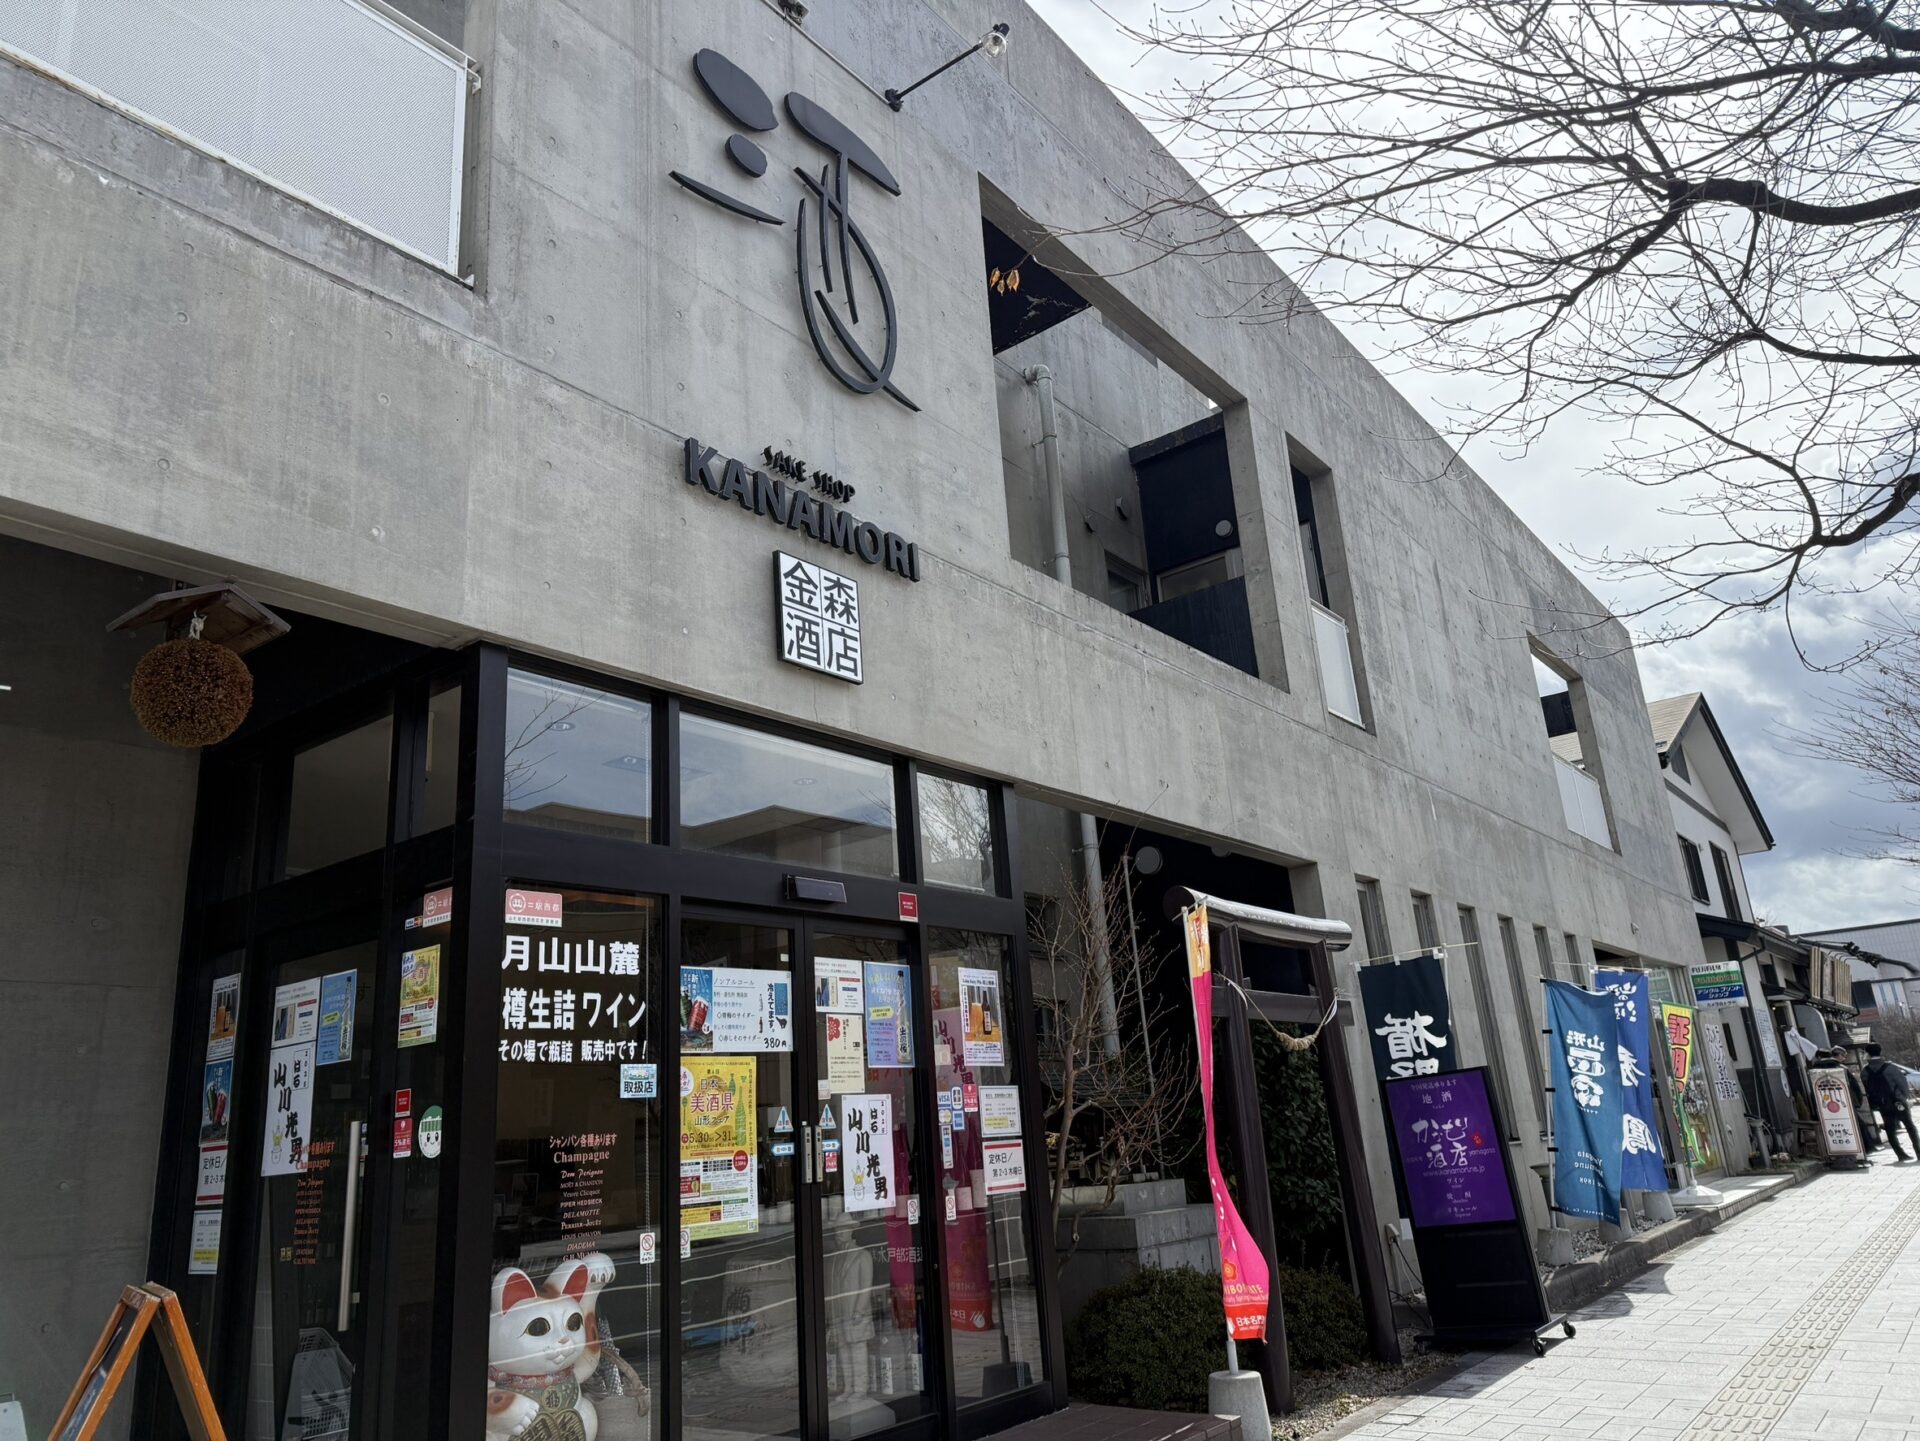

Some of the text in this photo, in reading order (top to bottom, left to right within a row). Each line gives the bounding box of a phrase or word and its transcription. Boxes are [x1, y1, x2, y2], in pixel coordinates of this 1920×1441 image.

[760, 445, 855, 503] SAKE SHOP
[684, 437, 920, 582] KANAMORI
[783, 561, 858, 625] 金森
[785, 611, 859, 677] 酒店
[501, 935, 640, 975] 月山山麓
[1692, 965, 1722, 973] FUJIFILM
[502, 987, 646, 1030] 樽生詰 ワイン
[498, 1039, 573, 1063] その場で瓶詰
[624, 1081, 654, 1094] 取扱店
[938, 1095, 950, 1103] VISA
[273, 1062, 303, 1164] 山川光男
[690, 1092, 735, 1114] 美酒県
[694, 1115, 730, 1126] 山形フェア
[870, 1108, 878, 1133] はる
[549, 1133, 617, 1148] シャンパン各種あります
[689, 1132, 710, 1143] 5.30
[553, 1150, 610, 1164] Champagne
[848, 1108, 888, 1200] 山川光男
[1426, 1142, 1468, 1168] 酒店
[563, 1209, 600, 1219] DELAMOTTE
